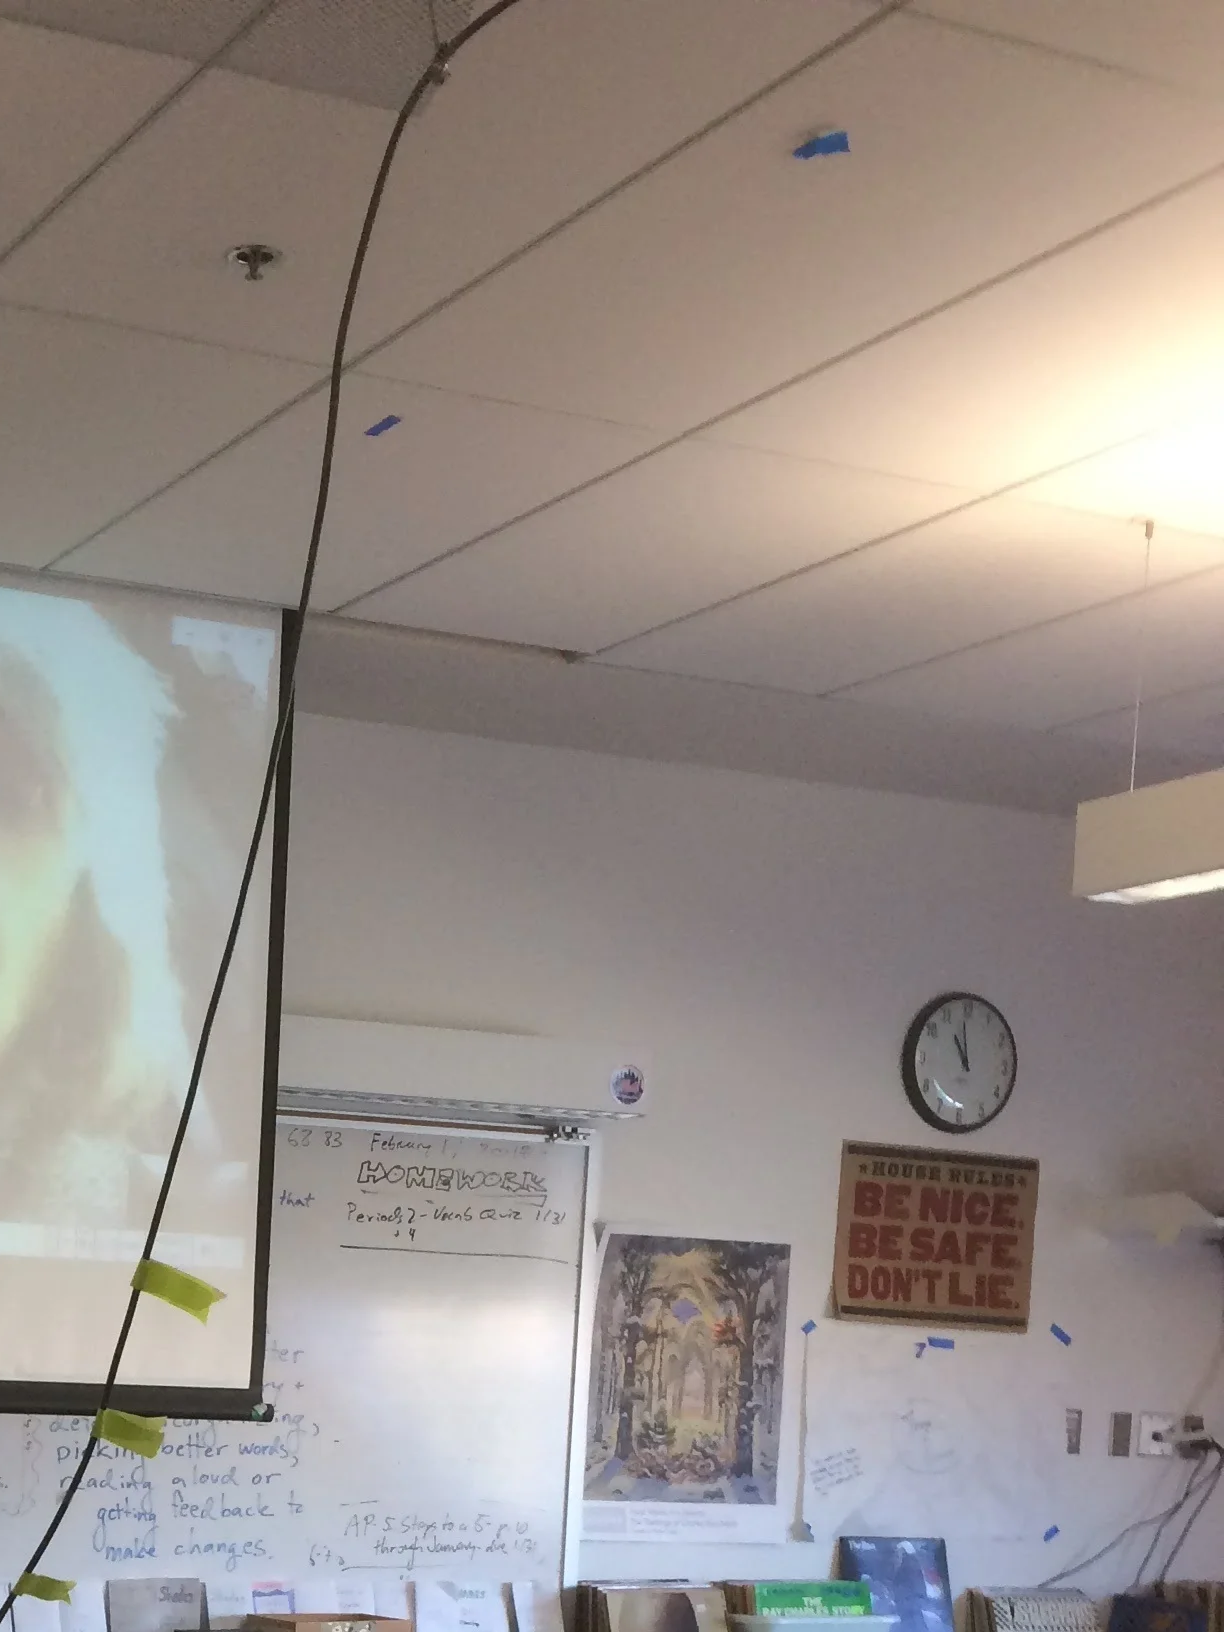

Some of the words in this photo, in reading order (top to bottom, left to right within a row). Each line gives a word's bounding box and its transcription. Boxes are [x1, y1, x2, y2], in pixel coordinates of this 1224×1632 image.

[357, 1160, 547, 1192] HOMEWORK
[872, 1161, 941, 1182] HOUSE
[949, 1168, 1015, 1187] RULES
[479, 1208, 523, 1221] Quiz
[854, 1181, 912, 1221] BE
[919, 1186, 1025, 1230] NICE.
[849, 1222, 904, 1260] BE
[909, 1227, 1022, 1269] SAFE.
[848, 1264, 942, 1304] DON'T
[949, 1272, 1020, 1309] LIE.
[161, 1435, 229, 1458] better
[238, 1436, 299, 1467] words,
[251, 1472, 282, 1485] or
[93, 1497, 157, 1552] getting
[172, 1490, 274, 1519] feedback
[104, 1538, 157, 1559] make
[174, 1526, 275, 1571] changes.
